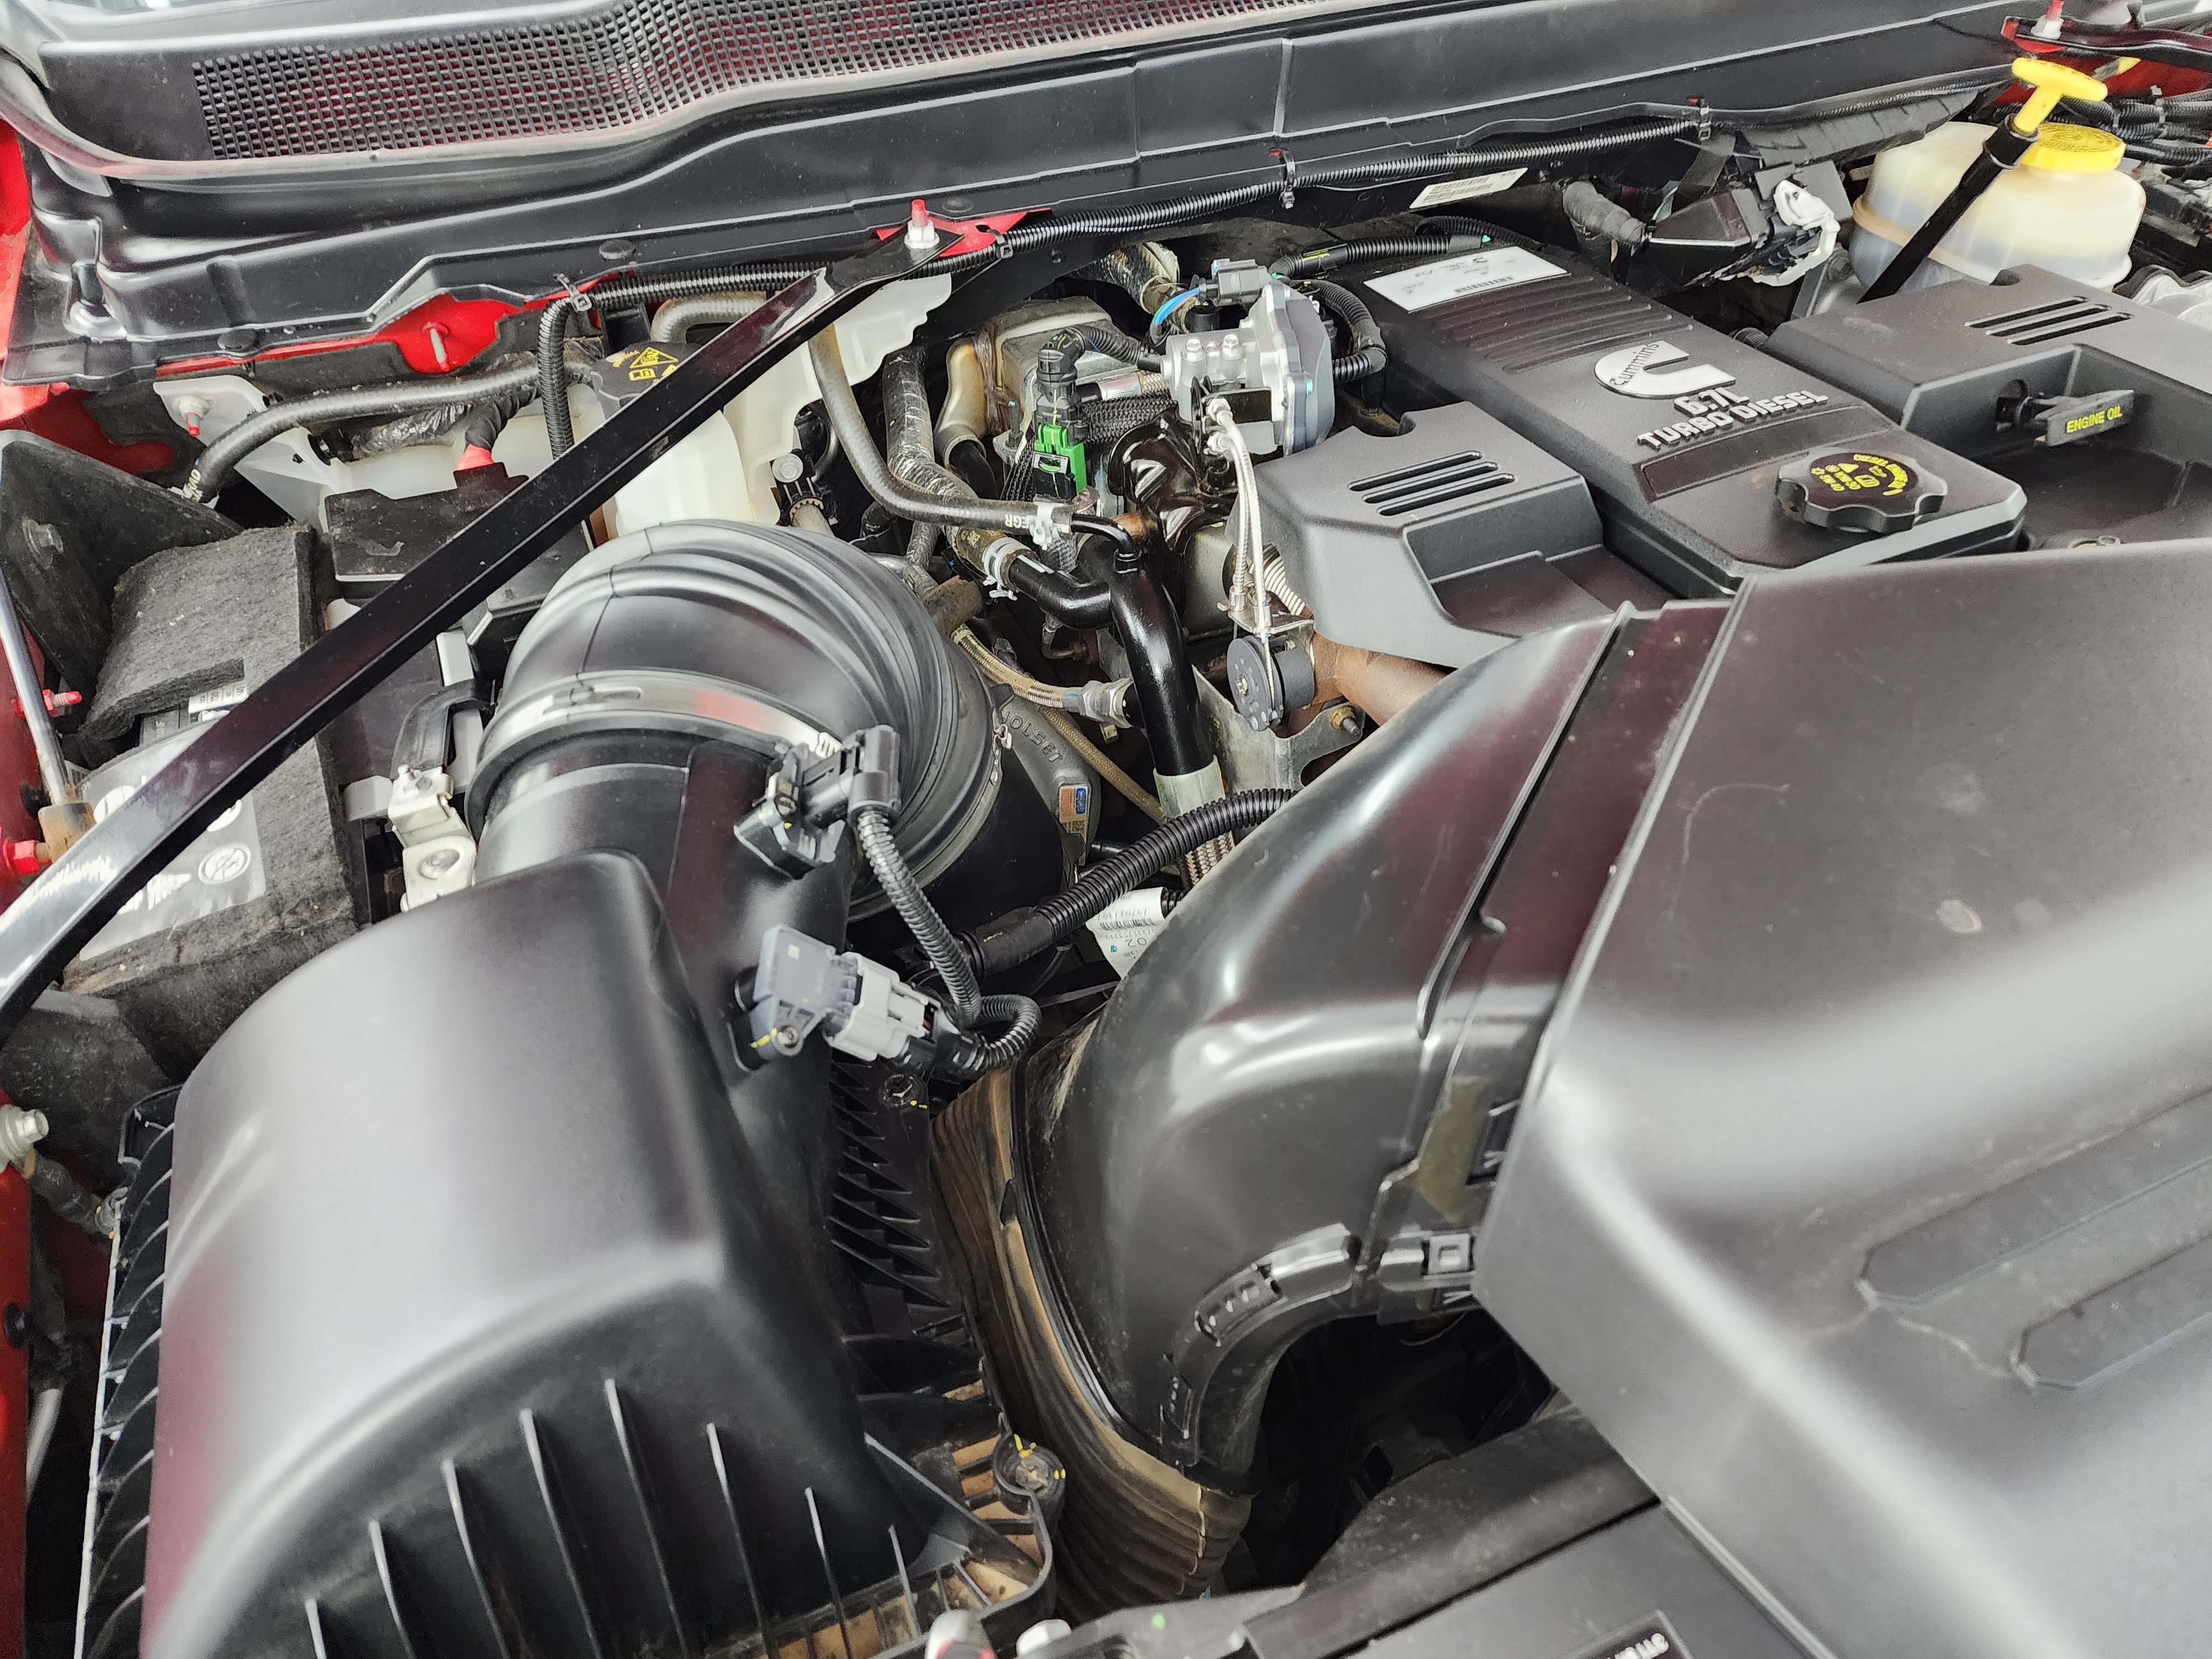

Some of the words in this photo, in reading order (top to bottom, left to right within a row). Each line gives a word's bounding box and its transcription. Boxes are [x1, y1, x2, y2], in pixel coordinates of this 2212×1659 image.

[1610, 341, 1660, 386] Cummins
[1673, 387, 1750, 418] 6.7L
[1637, 411, 1734, 450] TURBO
[1729, 389, 1829, 423] DIESEL
[2067, 410, 2105, 433] ENGINE
[2107, 405, 2123, 420] OIL
[1005, 514, 1029, 529] EGR
[1125, 937, 1147, 947] 02
